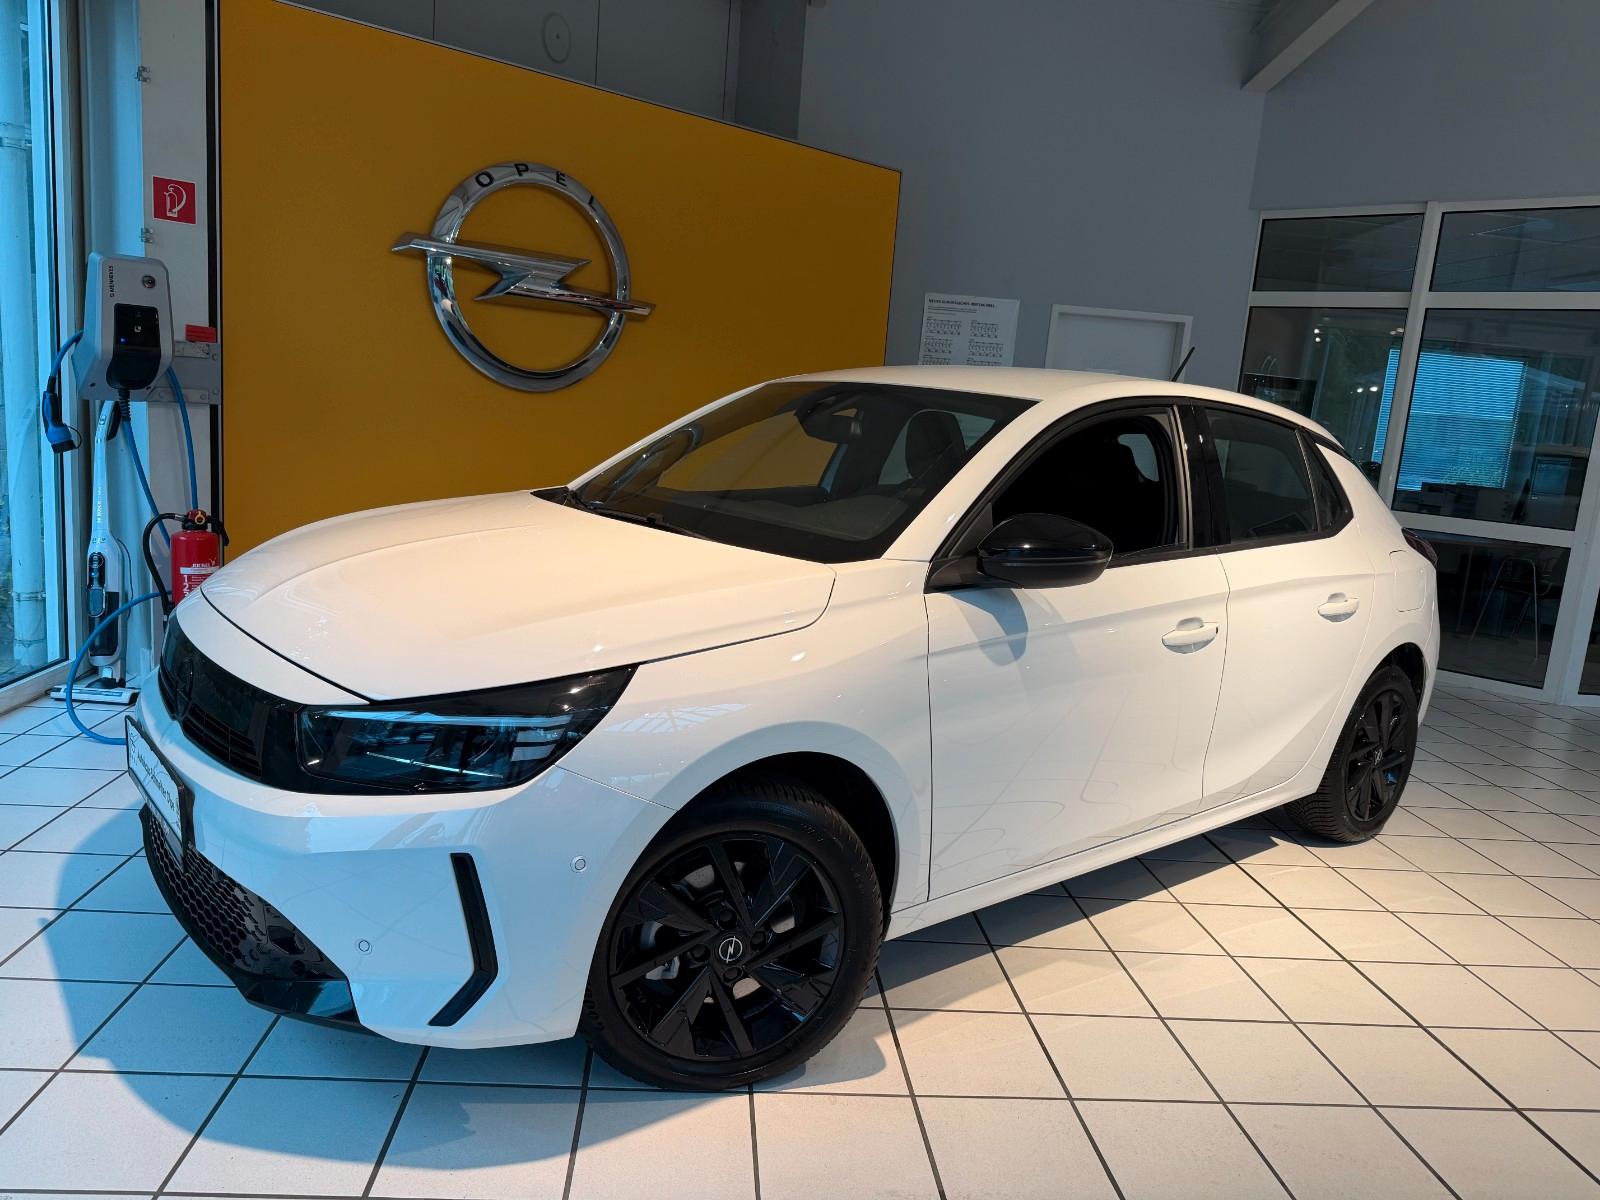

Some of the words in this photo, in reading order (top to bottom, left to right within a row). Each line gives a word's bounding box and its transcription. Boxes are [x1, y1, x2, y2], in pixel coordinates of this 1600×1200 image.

[474, 163, 597, 212] OPEL
[183, 574, 188, 583] 1
[182, 583, 190, 592] 2
